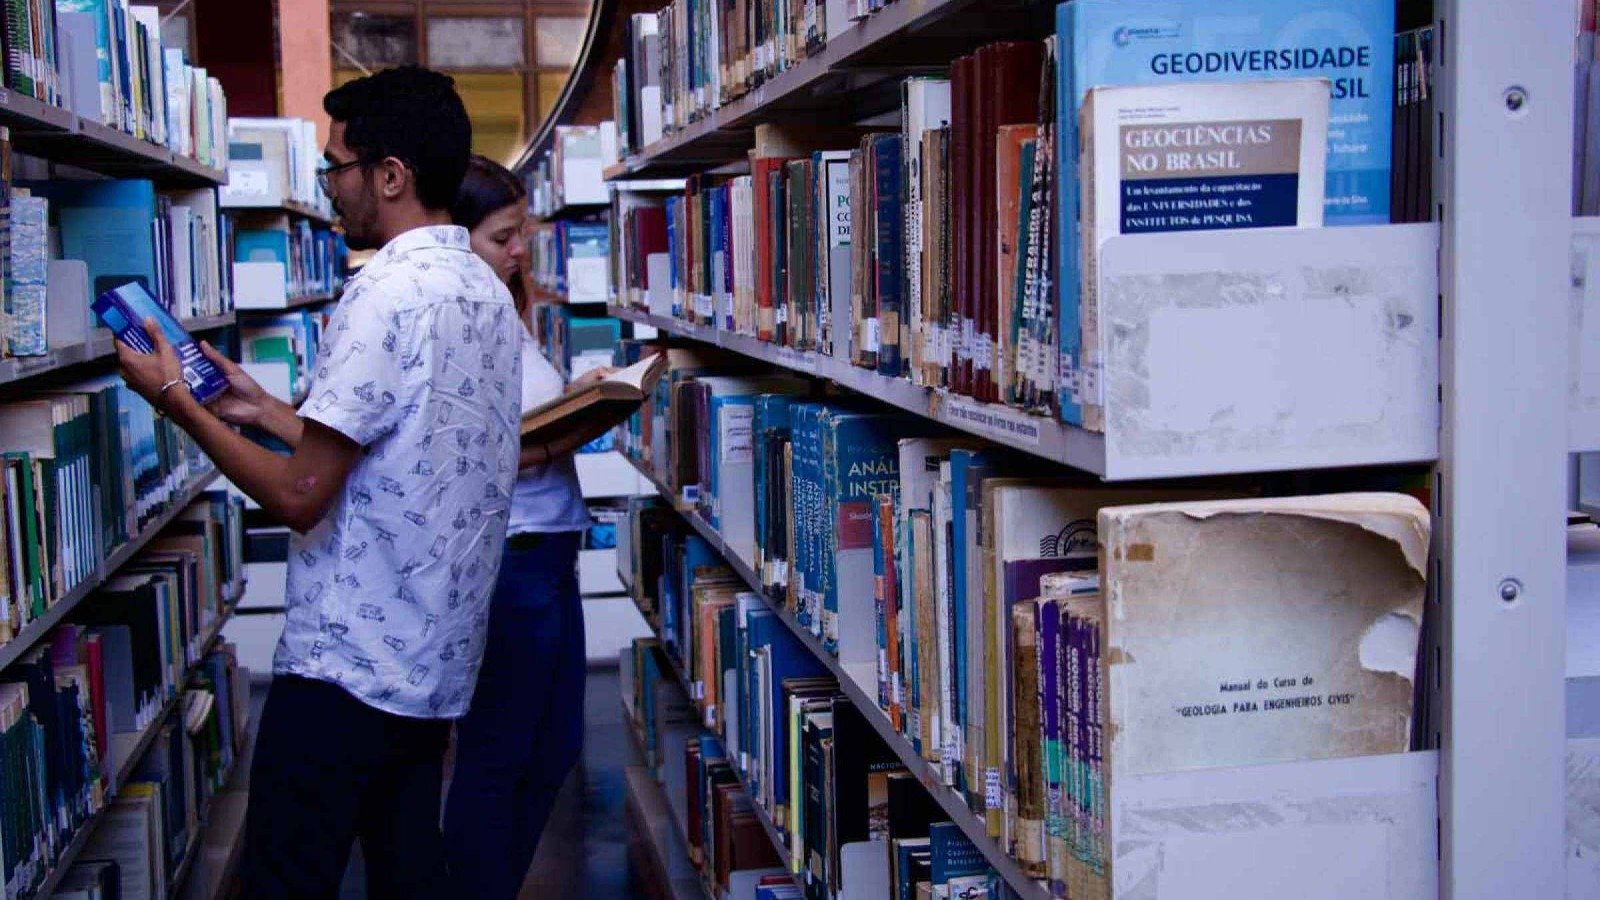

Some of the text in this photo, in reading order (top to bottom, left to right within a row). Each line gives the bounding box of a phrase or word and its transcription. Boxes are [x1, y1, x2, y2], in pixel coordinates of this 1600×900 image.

[1151, 46, 1369, 75] GEODIVERSIDADE
[1125, 124, 1272, 148] GEOCIÊNCIAS
[1127, 151, 1241, 172] NO BRASIL
[1126, 186, 1143, 196] Um
[1144, 185, 1199, 195] levantamento
[1200, 184, 1211, 193] da
[1126, 202, 1142, 212] das
[1144, 199, 1229, 211] UNIVERSIDADES
[1237, 198, 1252, 207] dos
[1126, 213, 1253, 228] INSTITUTOS de PESQUISA
[1220, 675, 1313, 693] Manual do Curso de
[1176, 693, 1356, 717] "GEOLOGIA PARA ENGENHEIROS CIVIS"
